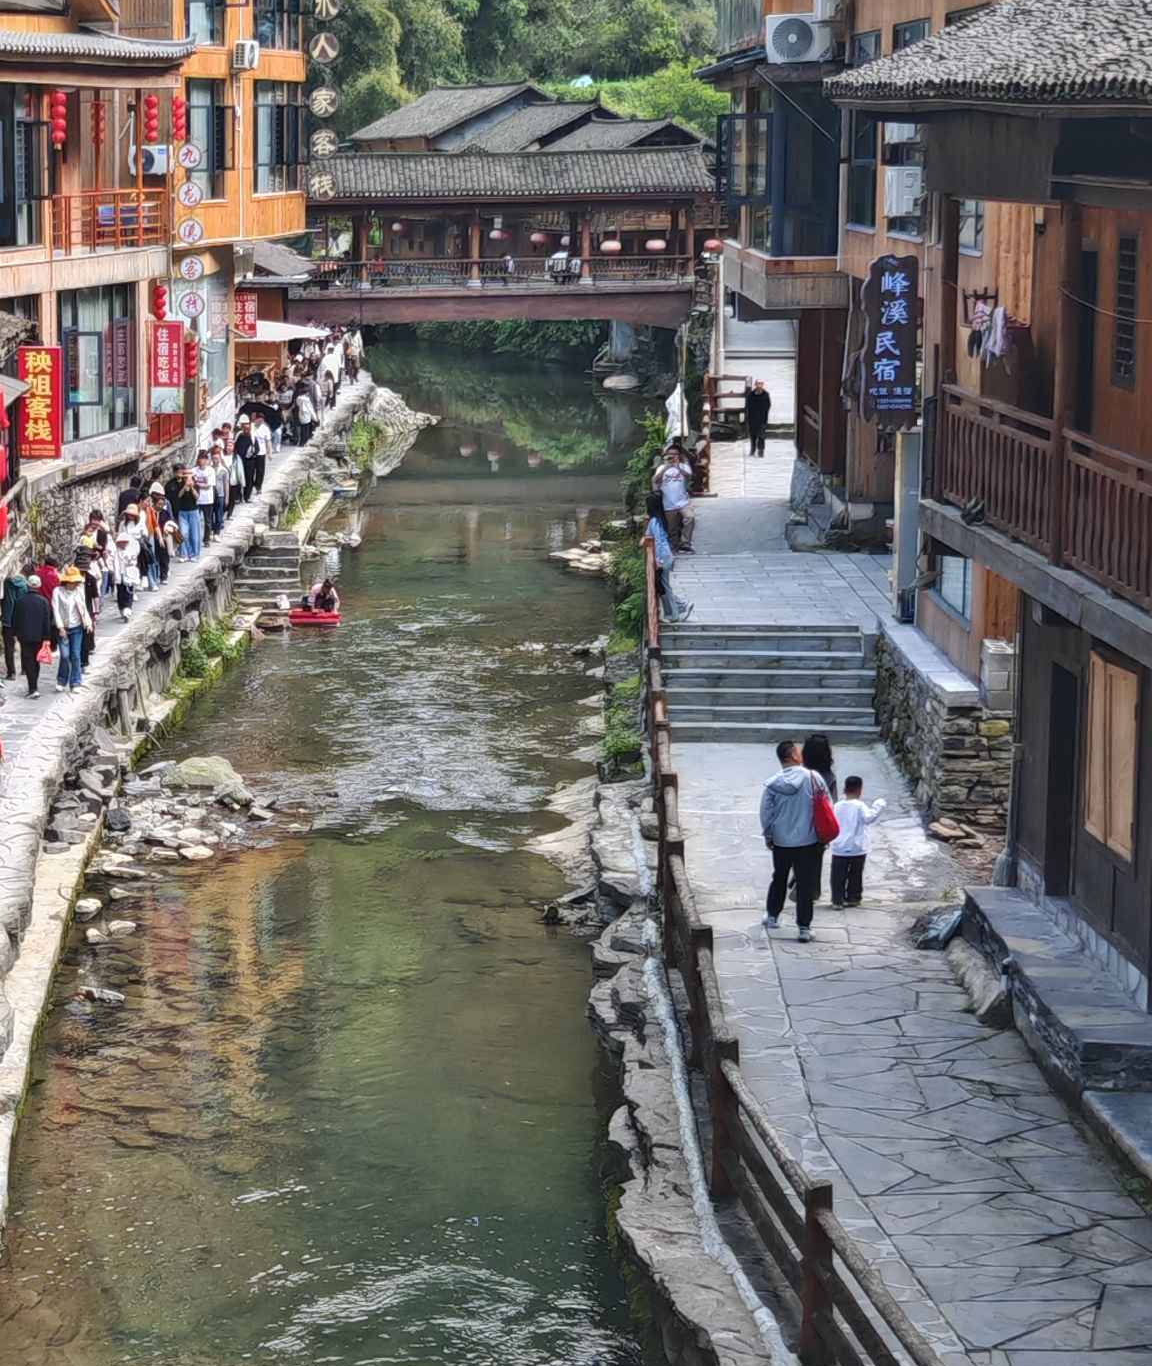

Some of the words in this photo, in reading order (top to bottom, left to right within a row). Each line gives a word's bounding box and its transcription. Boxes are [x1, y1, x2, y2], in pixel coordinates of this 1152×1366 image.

[872, 272, 911, 382] 峰溪民宿
[25, 350, 52, 441] 秧姐客栈
